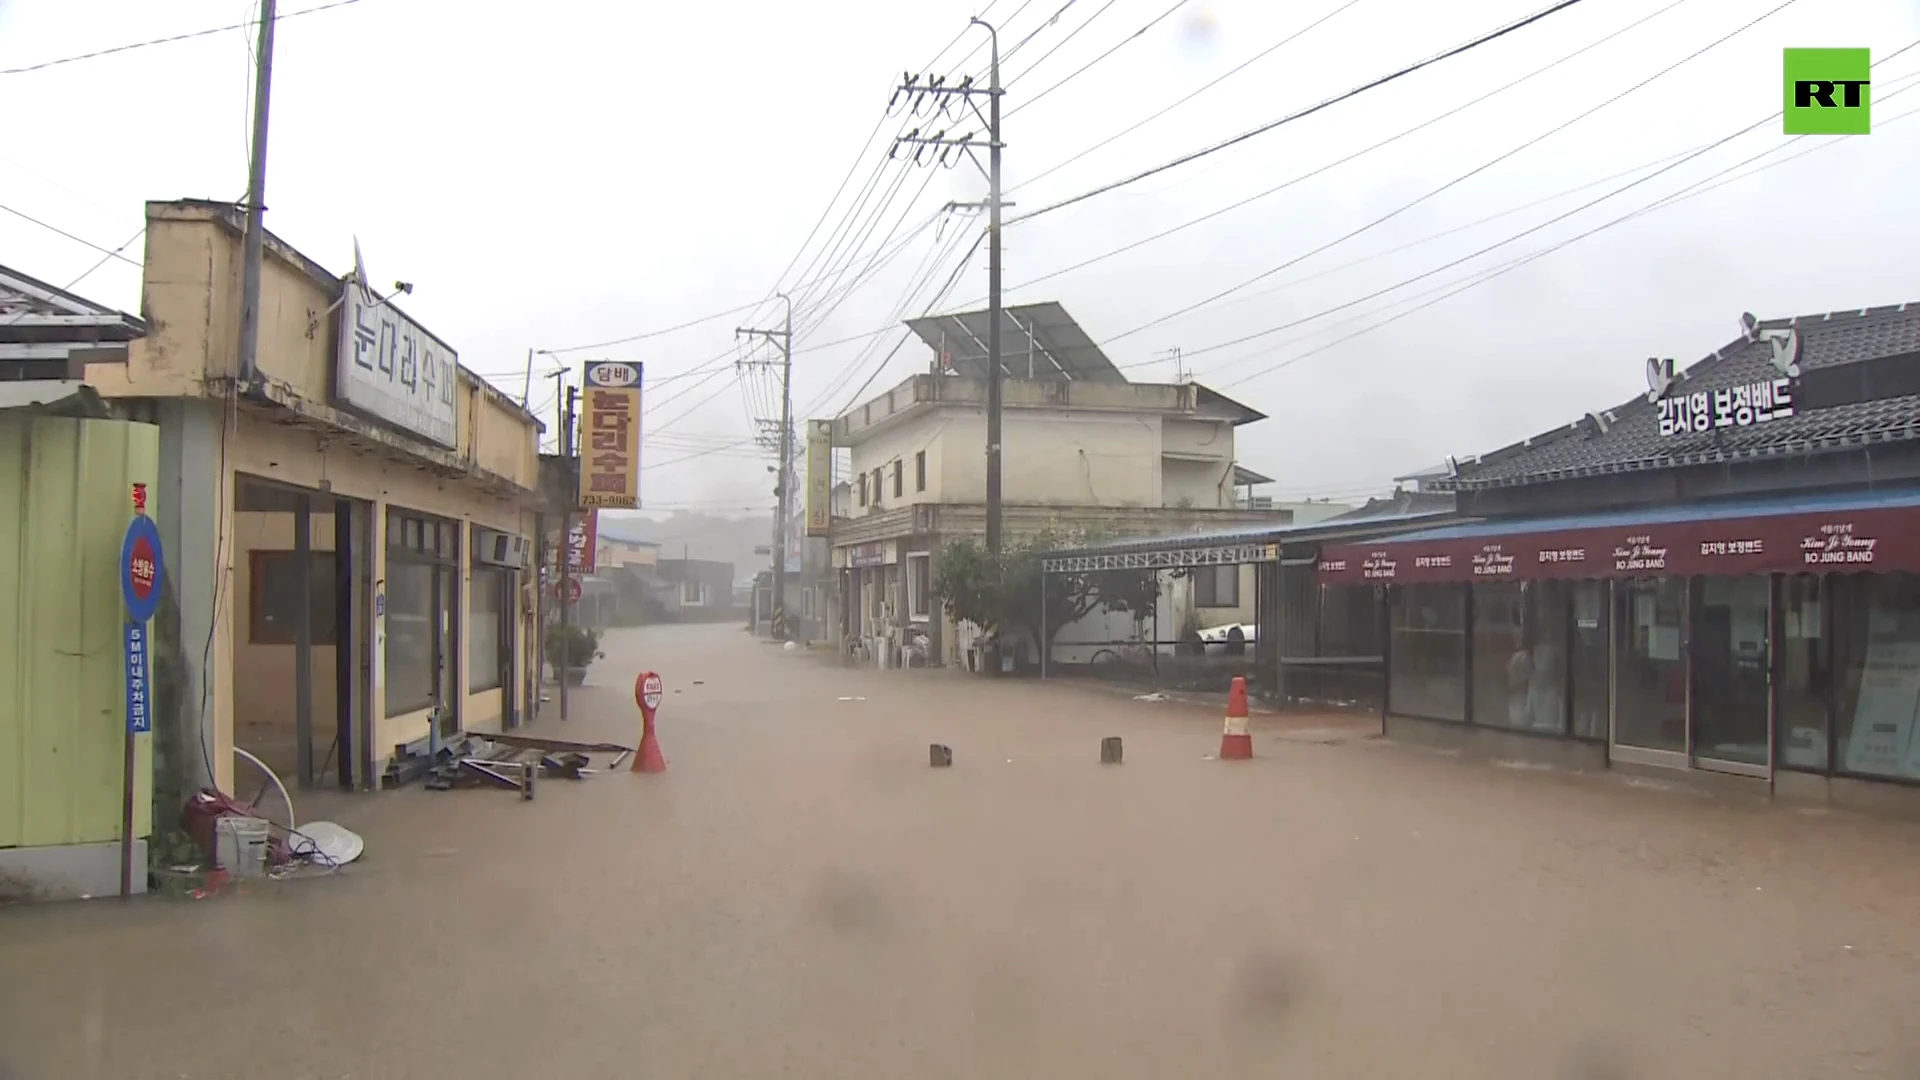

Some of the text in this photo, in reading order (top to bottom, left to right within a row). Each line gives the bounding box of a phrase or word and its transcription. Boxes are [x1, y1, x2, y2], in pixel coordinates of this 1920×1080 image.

[597, 366, 629, 382] 담배
[1657, 378, 1793, 436] 김지영 보정밴드
[1701, 540, 1763, 555] 김지영 보정밴드
[1800, 537, 1824, 548] Kim
[1841, 535, 1876, 550] Young
[1627, 560, 1644, 569] JUNG
[1646, 559, 1664, 568] BAND
[1805, 551, 1872, 563] BO JUNG BAND
